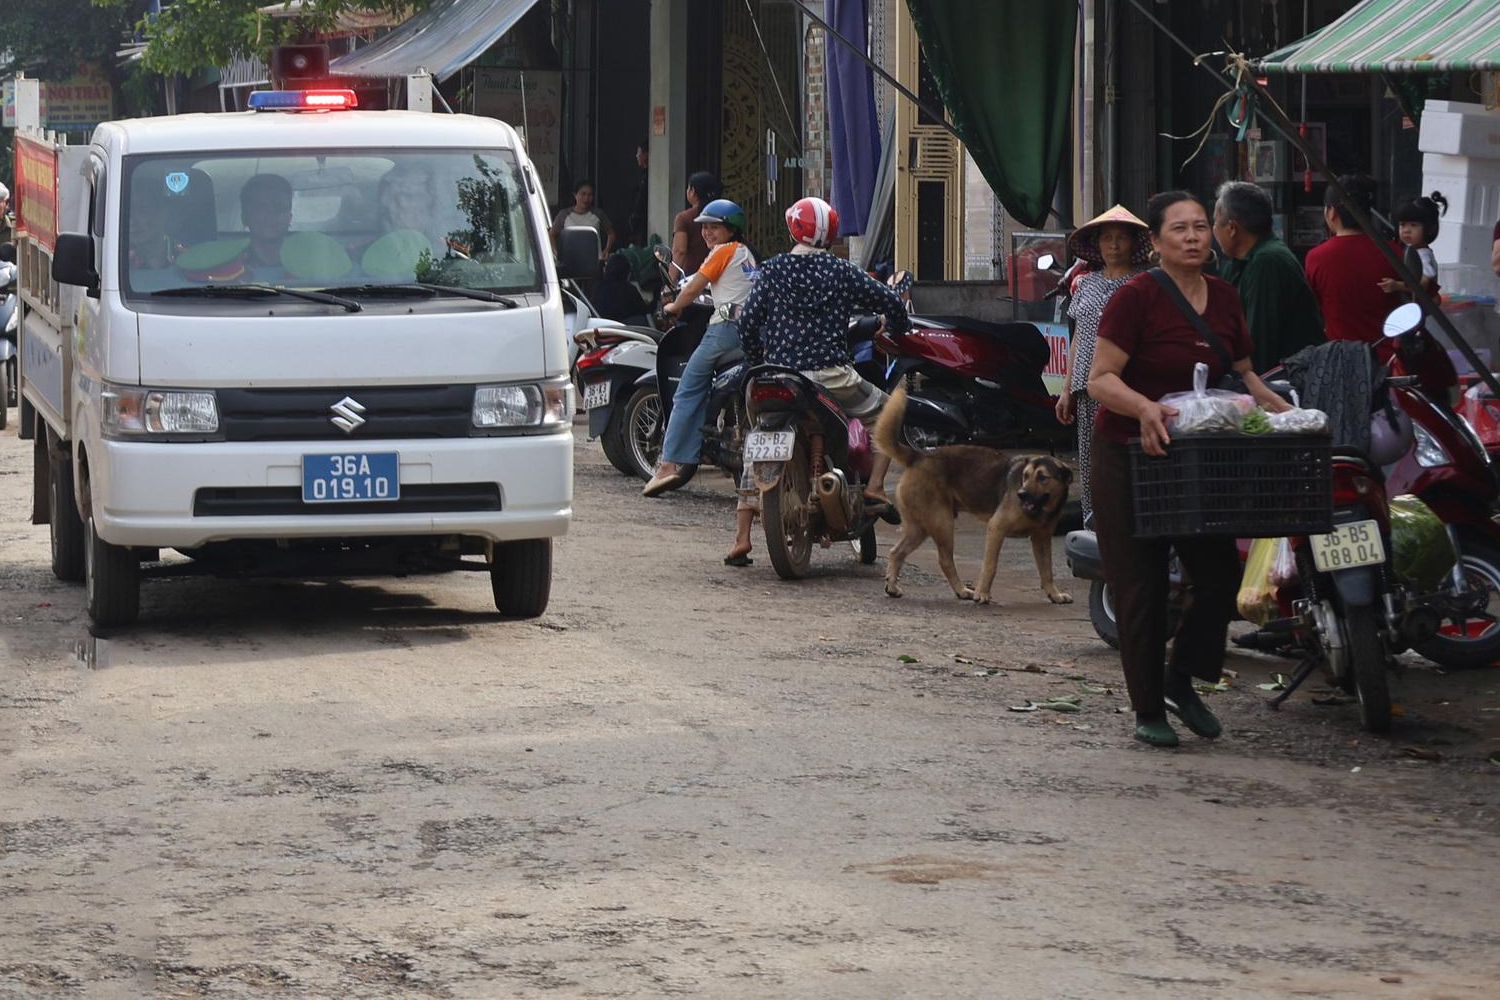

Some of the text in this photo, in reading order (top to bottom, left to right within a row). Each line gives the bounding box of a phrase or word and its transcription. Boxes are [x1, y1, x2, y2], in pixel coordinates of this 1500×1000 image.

[330, 454, 371, 476] 36A
[313, 477, 389, 499] 019.10
[1322, 525, 1369, 547] 36-B5
[1320, 543, 1379, 567] 188.04
